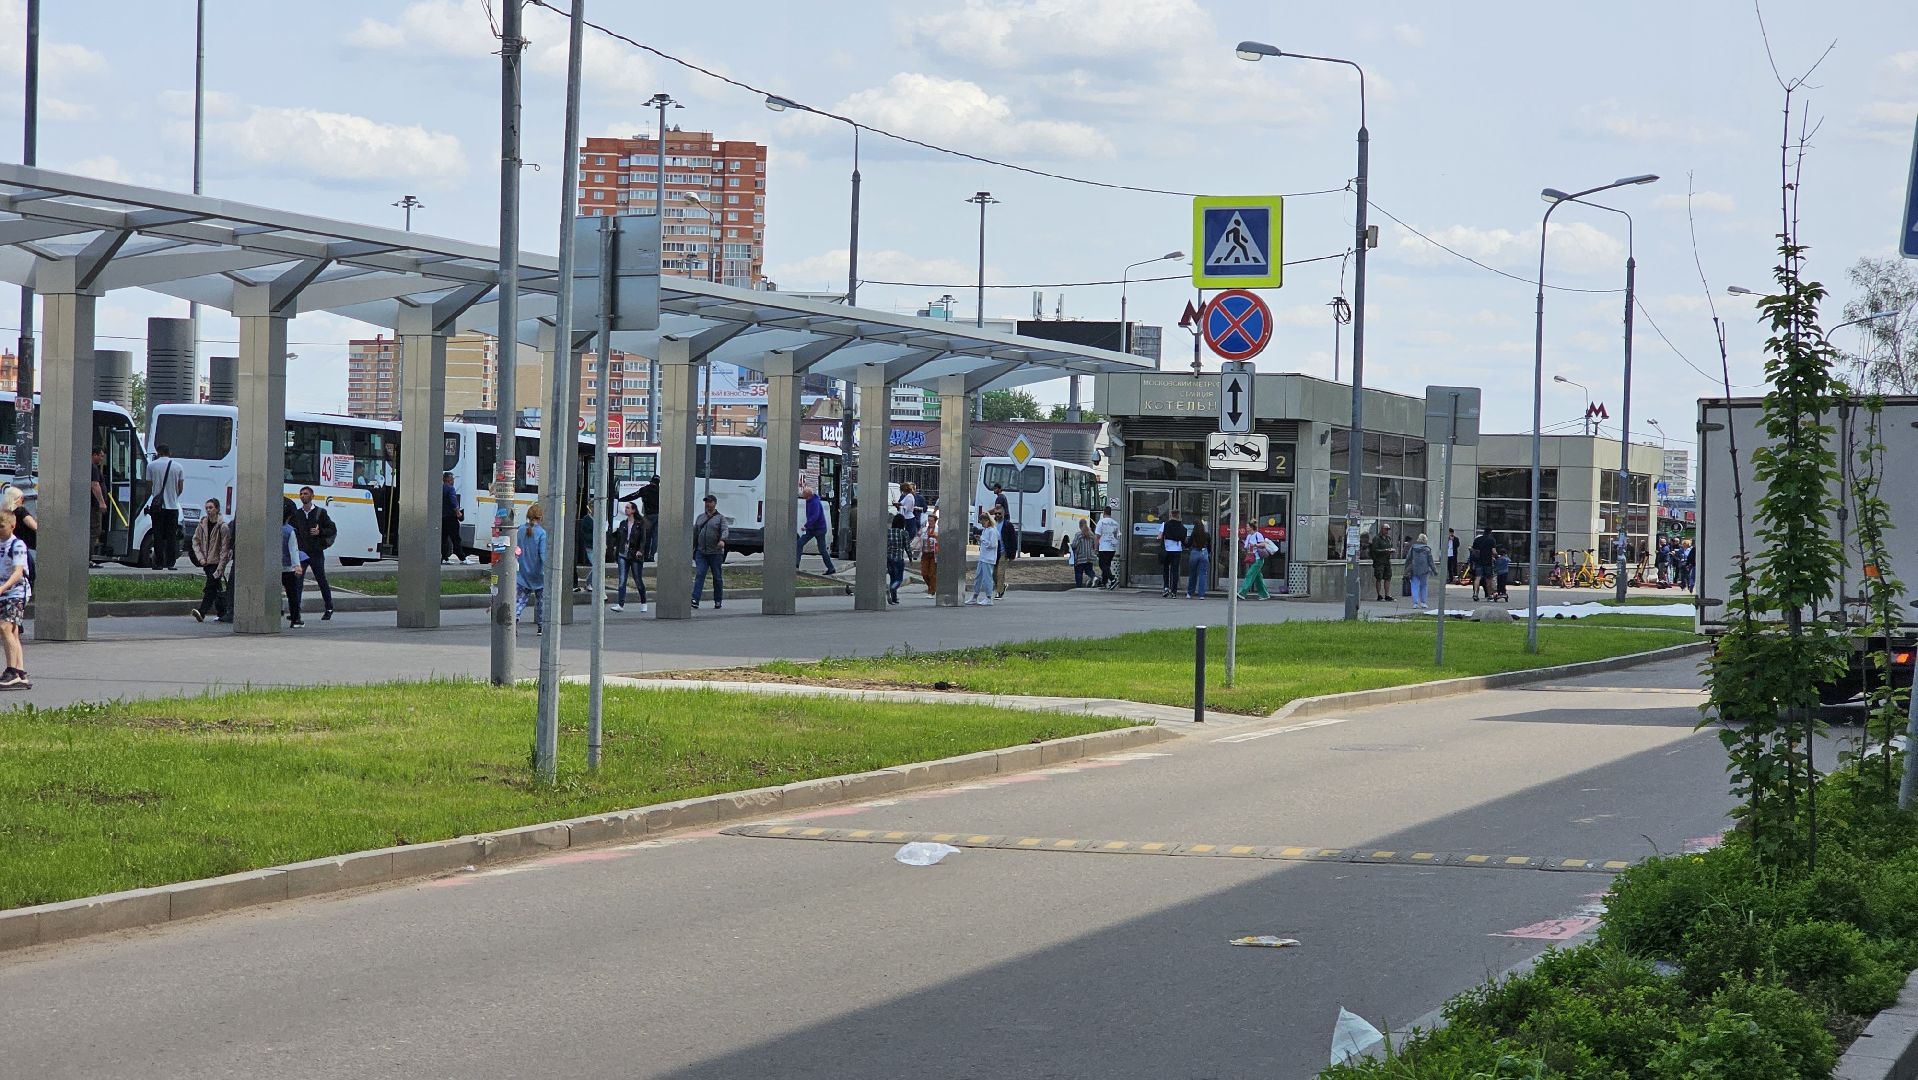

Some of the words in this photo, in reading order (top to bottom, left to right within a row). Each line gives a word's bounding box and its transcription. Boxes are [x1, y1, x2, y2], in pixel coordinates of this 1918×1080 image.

[1144, 400, 1217, 412] КОТЕЛЬН
[321, 456, 332, 482] 43
[1276, 456, 1286, 470] 2
[527, 463, 536, 478] 43
